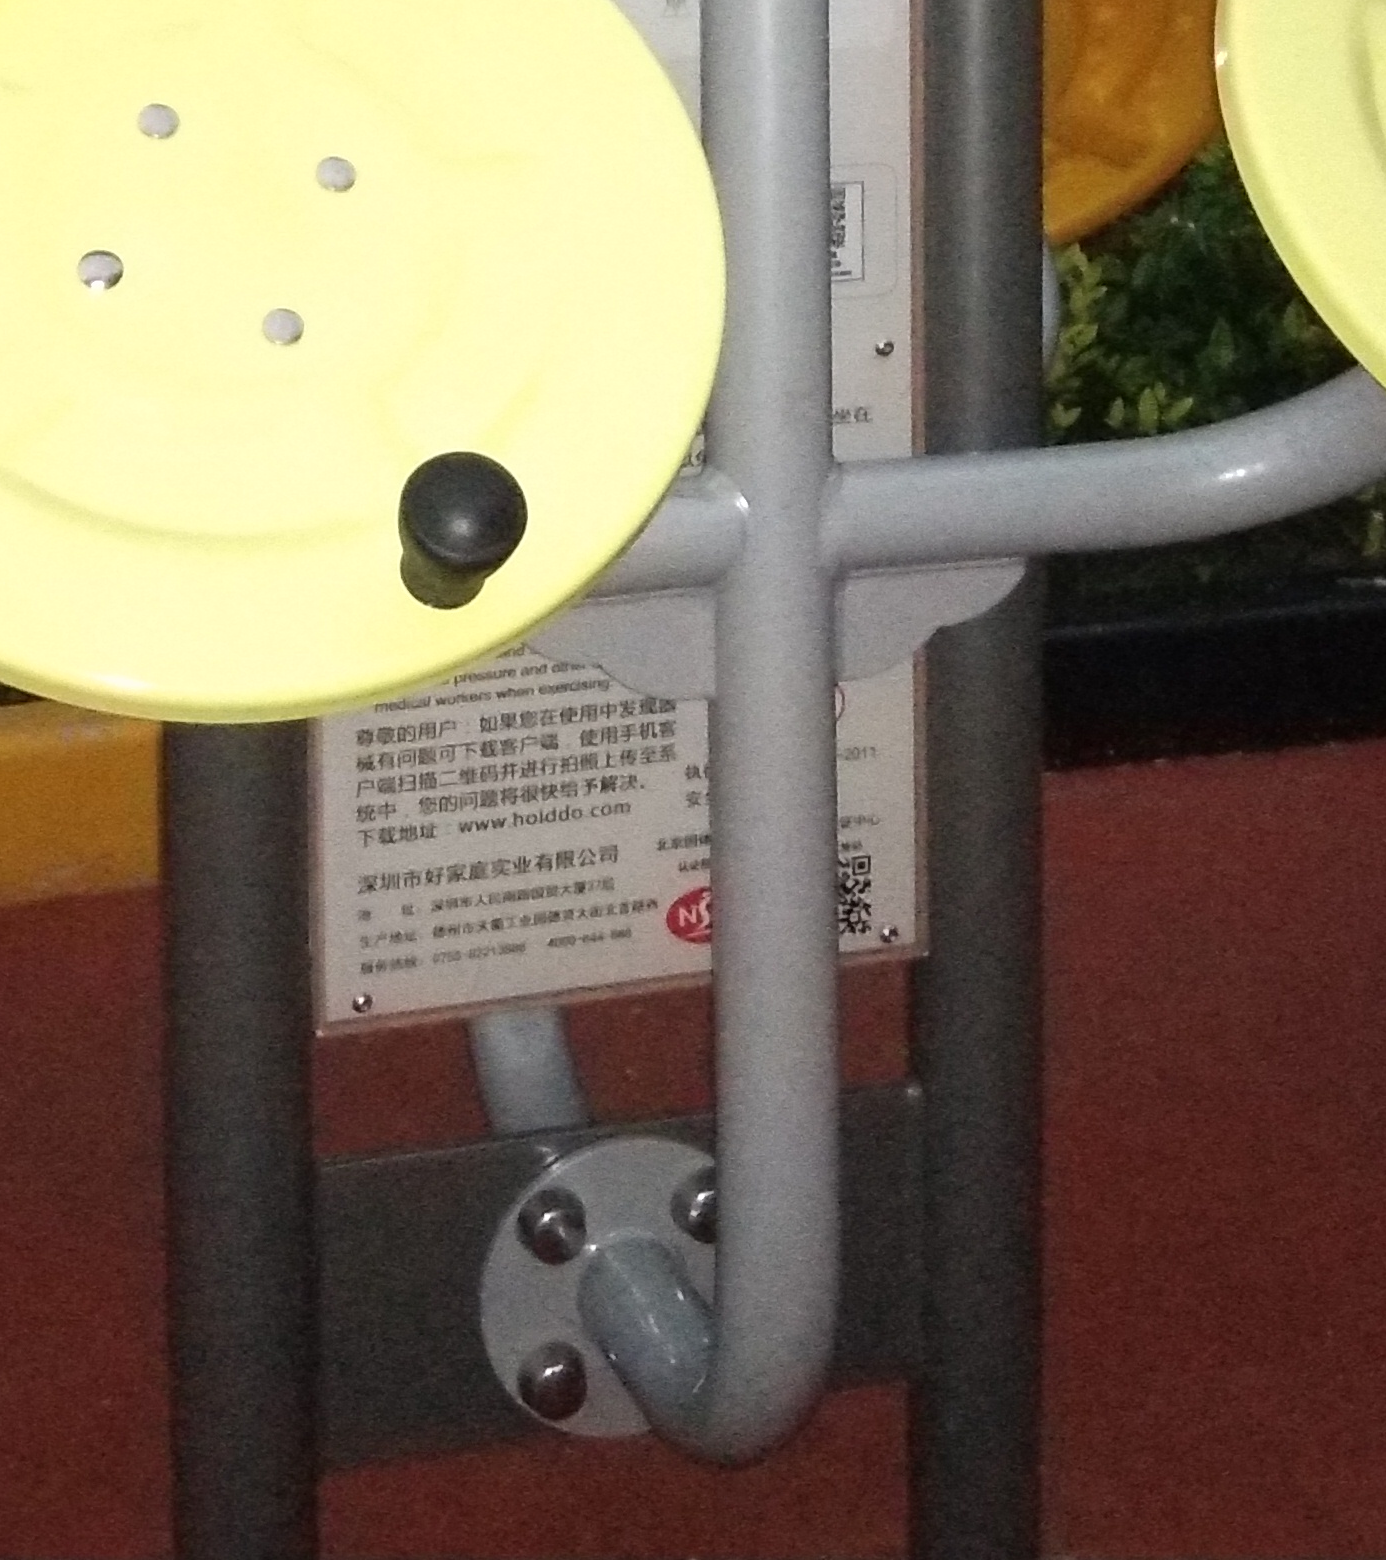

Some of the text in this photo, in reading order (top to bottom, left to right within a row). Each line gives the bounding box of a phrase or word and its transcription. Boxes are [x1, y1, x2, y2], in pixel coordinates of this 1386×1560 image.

[520, 662, 548, 677] and
[435, 691, 492, 707] workers
[495, 686, 535, 701] when
[538, 678, 610, 696] exercising
